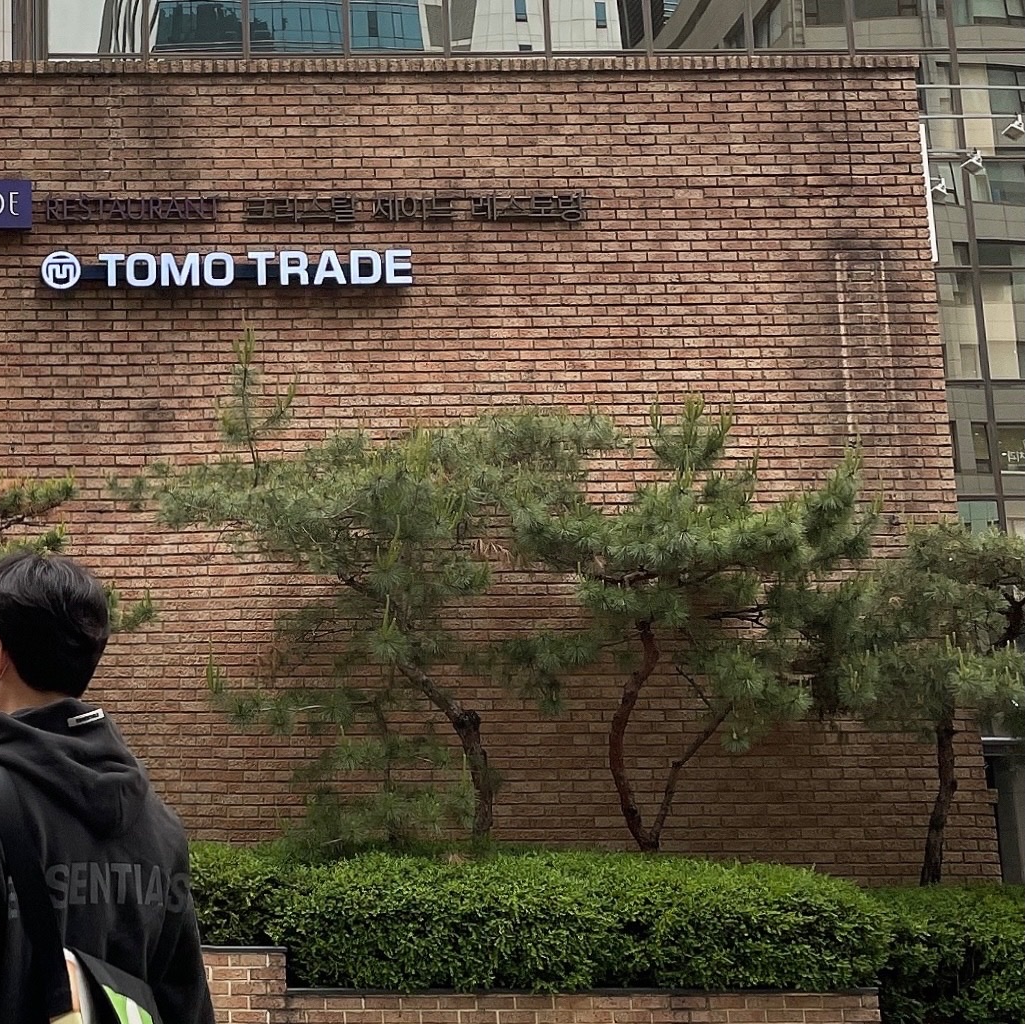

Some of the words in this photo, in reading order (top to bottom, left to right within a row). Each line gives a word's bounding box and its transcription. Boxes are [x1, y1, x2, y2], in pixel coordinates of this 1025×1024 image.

[45, 196, 218, 221] RESTAURANT
[242, 196, 357, 222] 크리스탈
[373, 195, 452, 221] 제이드
[471, 194, 586, 222] 레스토랑
[98, 250, 236, 288] TOMO
[247, 248, 413, 287] TRADE
